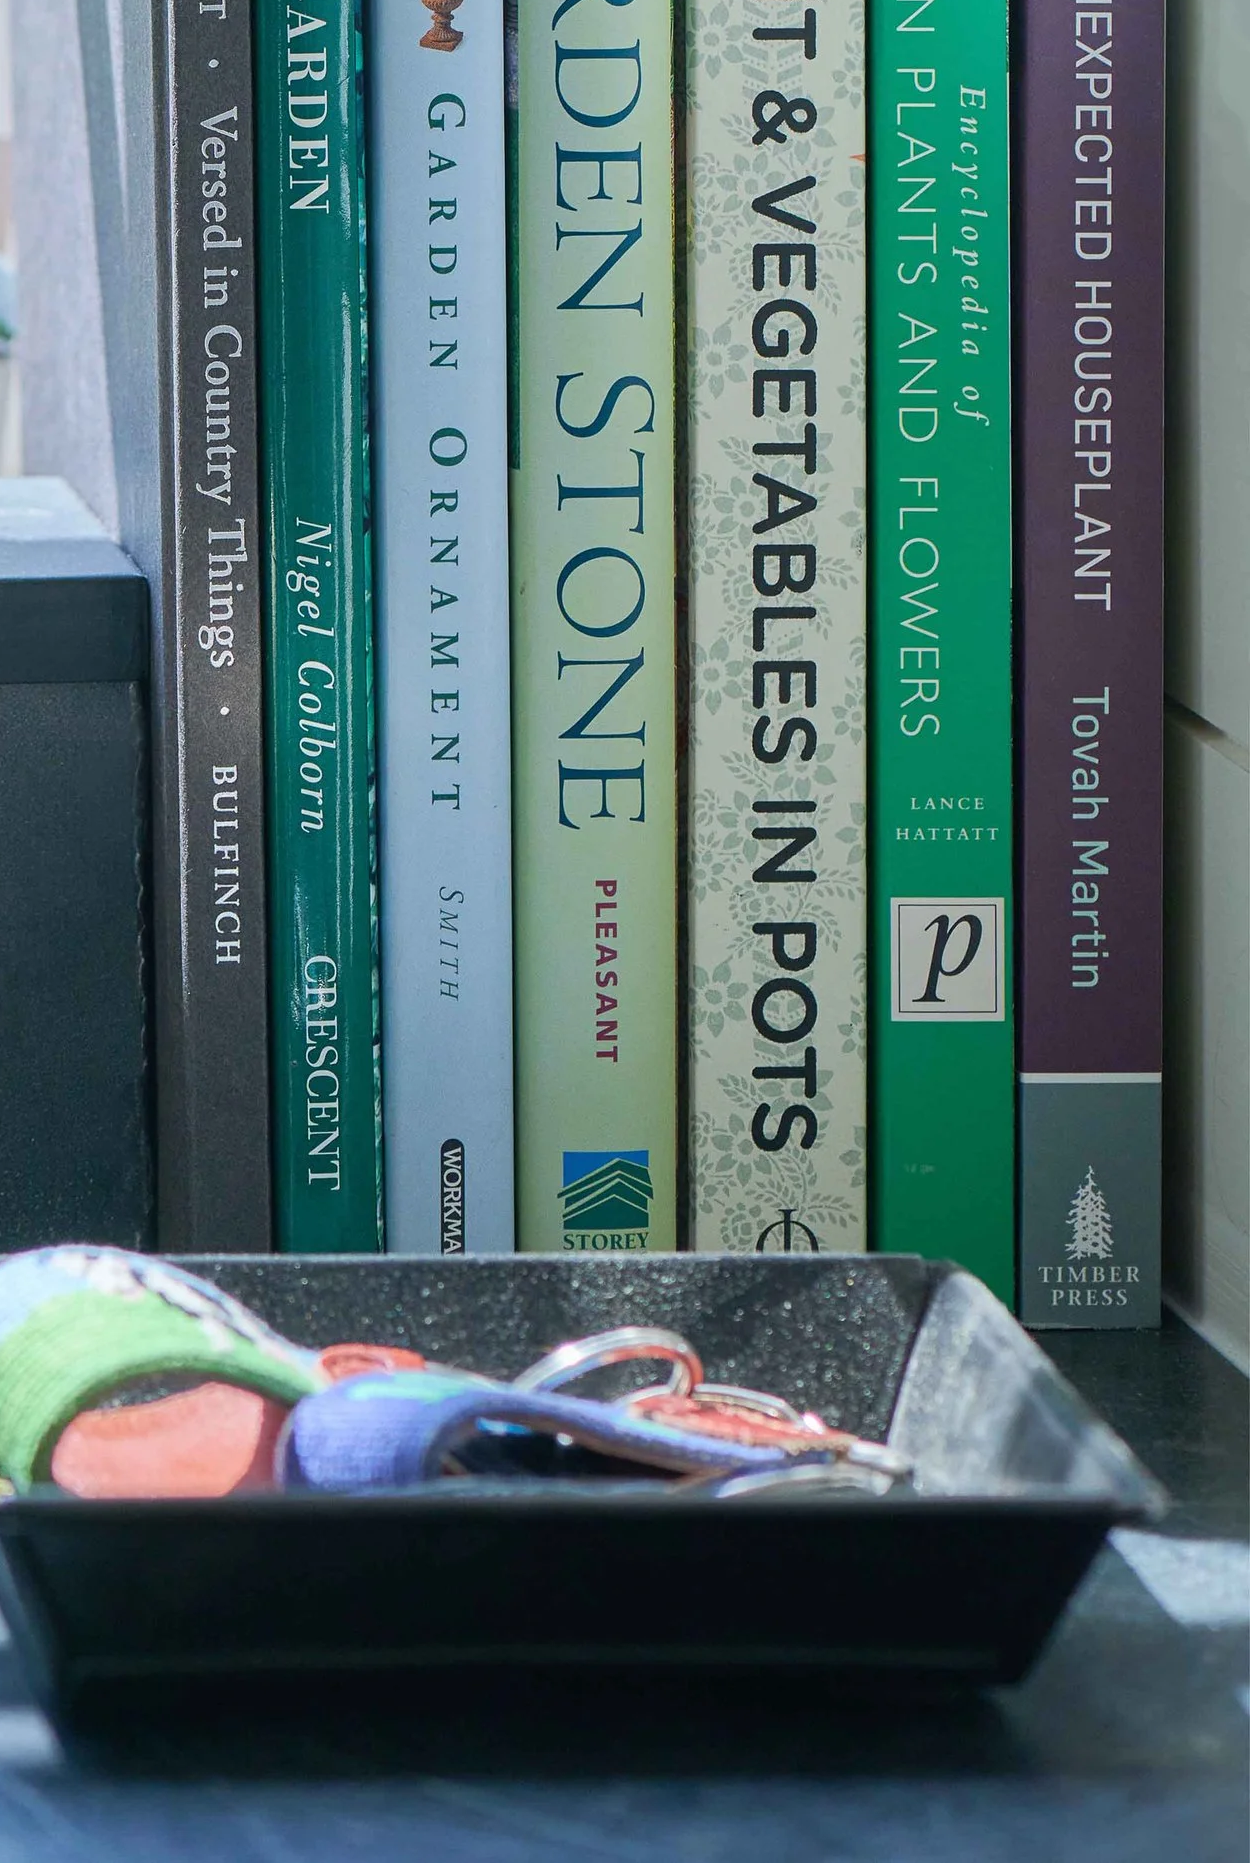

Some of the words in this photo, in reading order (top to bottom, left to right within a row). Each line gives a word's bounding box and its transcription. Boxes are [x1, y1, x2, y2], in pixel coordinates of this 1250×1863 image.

[200, 106, 243, 251] Versed
[752, 90, 817, 145] &
[897, 69, 937, 284] PLANTS
[204, 266, 238, 309] in
[428, 93, 465, 370] GARDEN
[953, 85, 988, 354] Encyclopedia
[196, 325, 242, 505] Country
[899, 313, 937, 442] AND
[954, 386, 989, 426] of
[1074, 282, 1112, 610] HOUSEPLANT
[752, 176, 817, 763] VEGETABLES
[198, 519, 247, 667] Things
[286, 517, 334, 636] Nigel
[430, 428, 467, 810] ORNAMENT
[556, 372, 654, 829] STONE
[899, 478, 939, 736] FLOWERS
[298, 661, 335, 833] Colborn
[910, 797, 985, 810] LANCE
[1072, 687, 1109, 819] Tovah
[213, 765, 240, 964] BULFINCH
[752, 801, 817, 882] IN
[895, 827, 999, 841] HATTATT
[439, 887, 464, 1001] SMITH
[596, 880, 617, 1062] PLEASANT
[1072, 841, 1109, 987] Martin
[303, 955, 340, 1190] CRESCENT
[751, 922, 817, 1151] POTS
[443, 1148, 463, 1255] WORKMA
[563, 1232, 648, 1252] STOREY
[1038, 1266, 1140, 1283] TIMBER
[1052, 1288, 1128, 1306] PRESS
